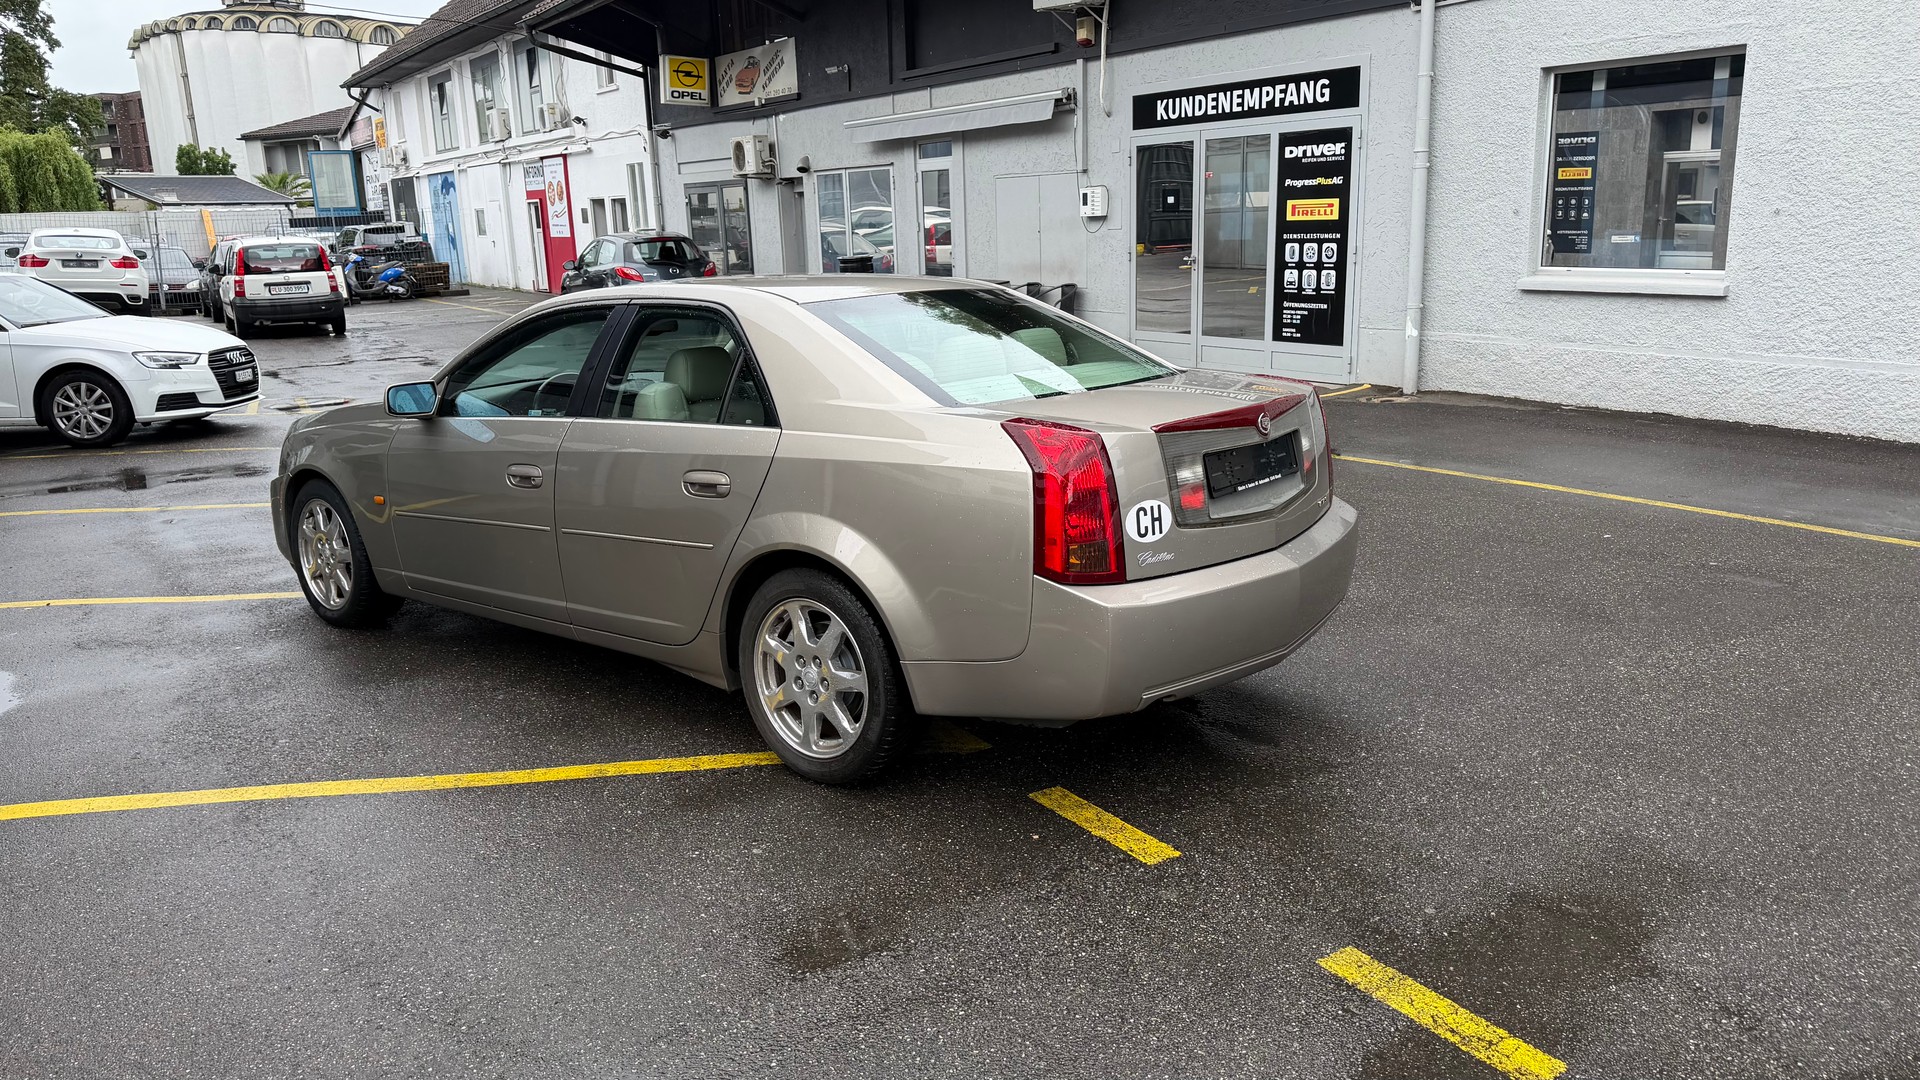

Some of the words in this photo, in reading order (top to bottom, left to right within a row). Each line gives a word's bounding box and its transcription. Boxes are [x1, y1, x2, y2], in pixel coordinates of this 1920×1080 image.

[671, 90, 706, 101] OPEL
[1156, 79, 1330, 121] KUNDENEMPFANG
[1285, 176, 1344, 188] ProgressPlusAG
[1291, 203, 1334, 216] PIRELLI
[1136, 504, 1163, 538] CH
[1137, 551, 1175, 567] Cadillac
